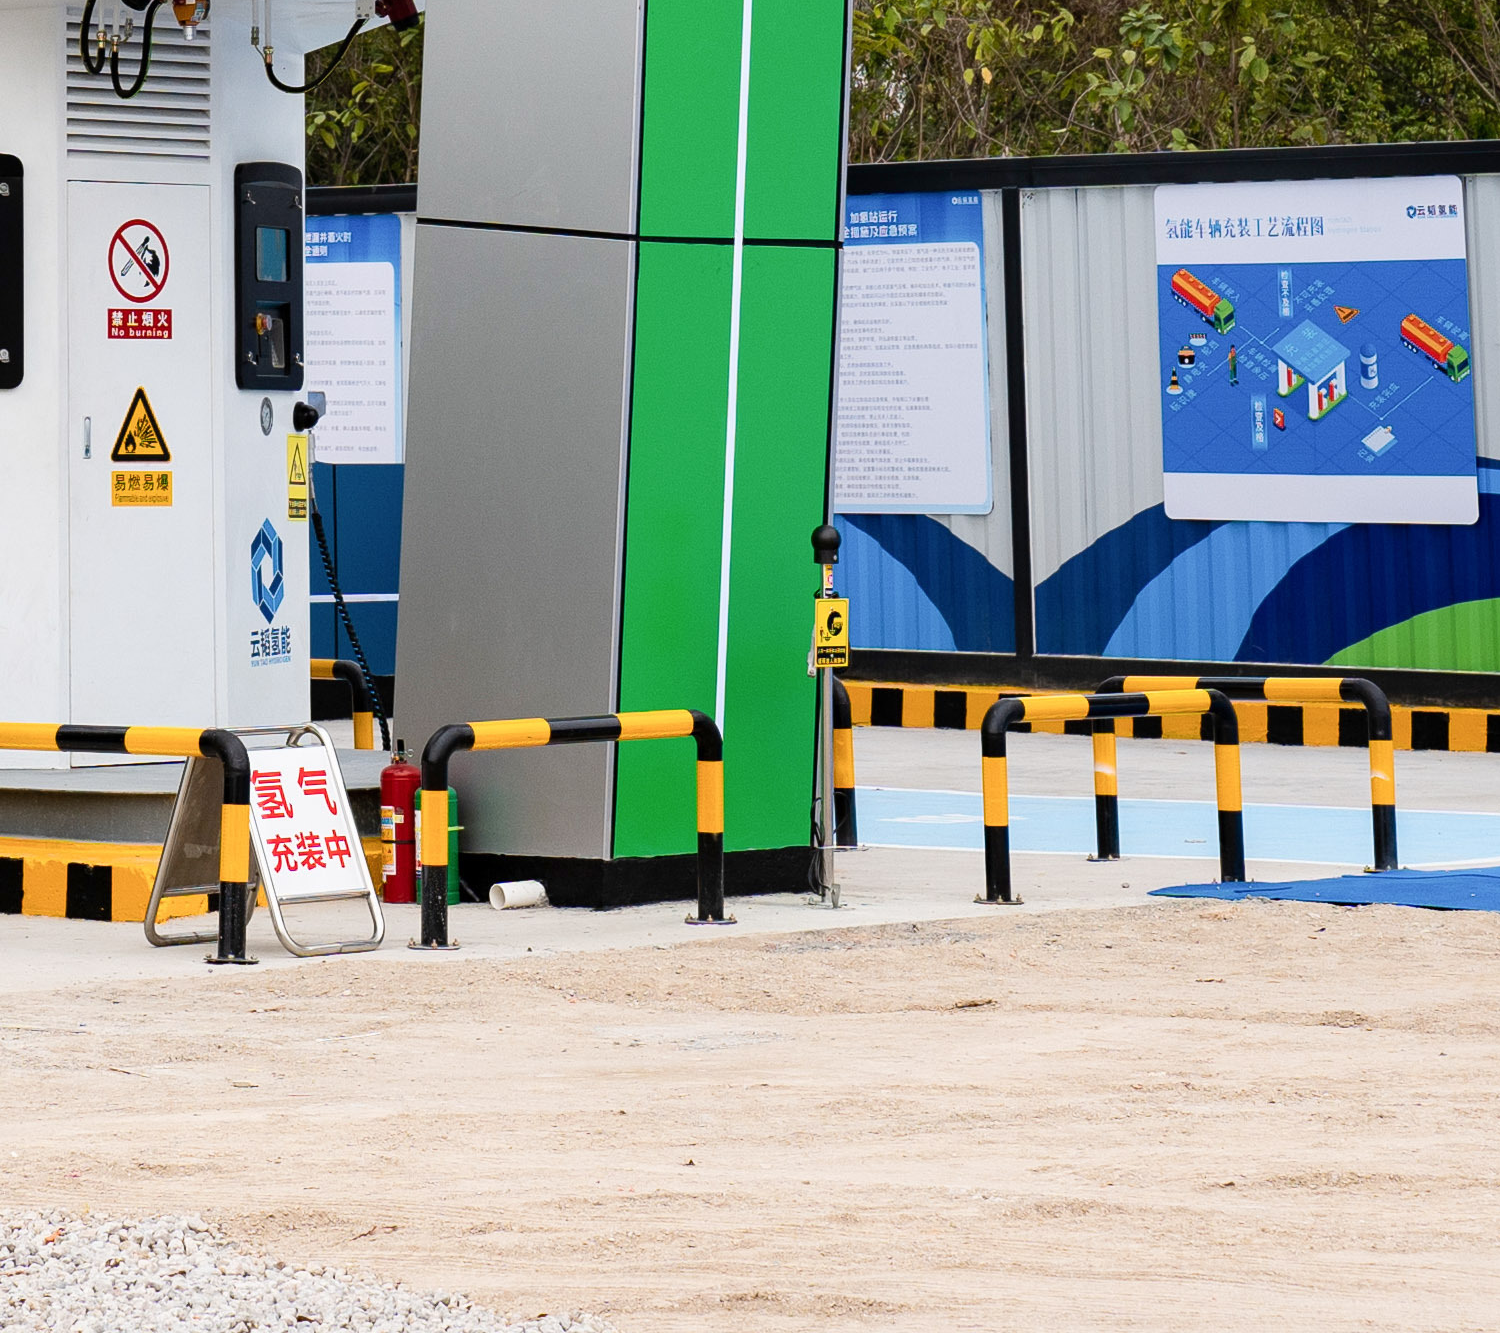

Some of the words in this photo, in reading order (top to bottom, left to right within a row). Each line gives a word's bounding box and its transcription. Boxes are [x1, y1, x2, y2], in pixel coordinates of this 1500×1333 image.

[1165, 216, 1324, 239] 氢能车辆充装工艺流程图
[111, 310, 169, 327] 禁止烟火
[111, 327, 125, 337] No
[129, 327, 169, 339] burning
[114, 473, 169, 492] 易燃易爆
[250, 767, 338, 819] 氢气
[266, 829, 352, 873] 充装中
